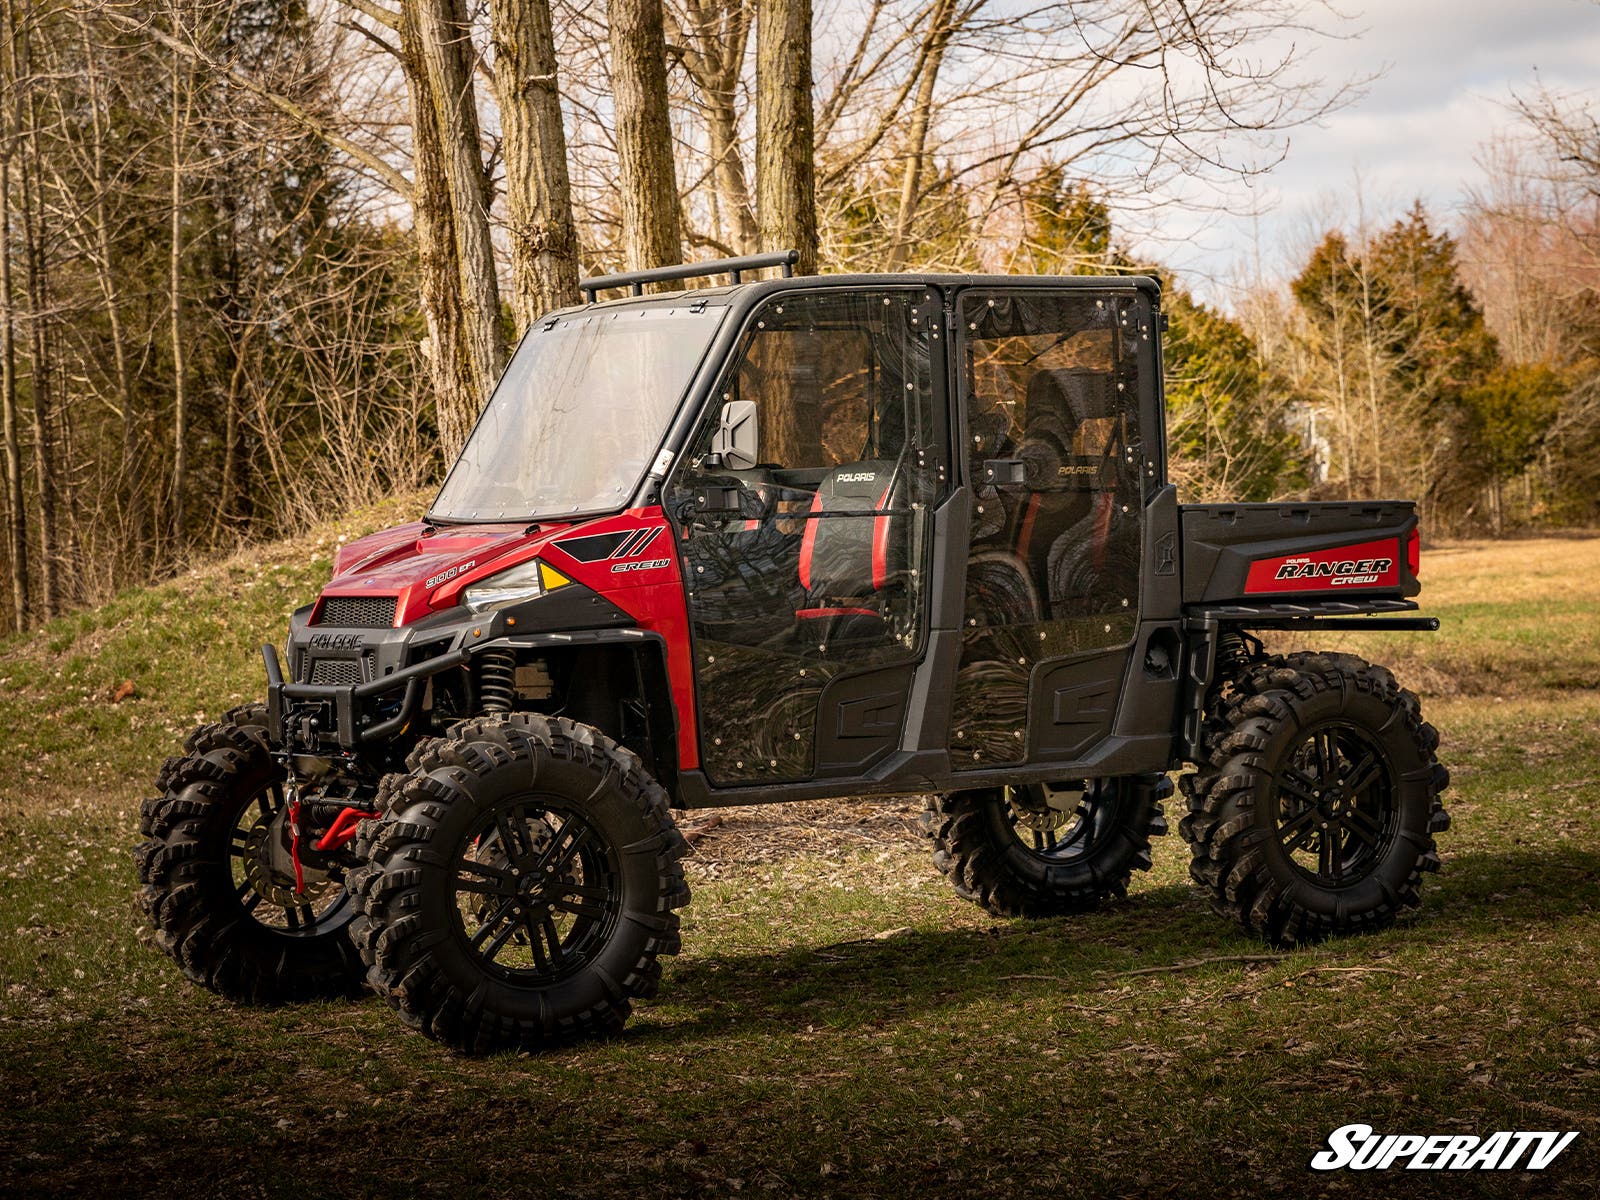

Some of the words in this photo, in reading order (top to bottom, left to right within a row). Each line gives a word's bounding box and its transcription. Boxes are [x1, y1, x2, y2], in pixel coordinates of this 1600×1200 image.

[837, 472, 876, 482] POLARIS
[611, 558, 671, 574] CREW
[1274, 558, 1392, 579] RANGER
[426, 566, 457, 589] 900
[1331, 575, 1378, 585] CREW
[308, 633, 366, 651] POLARIS
